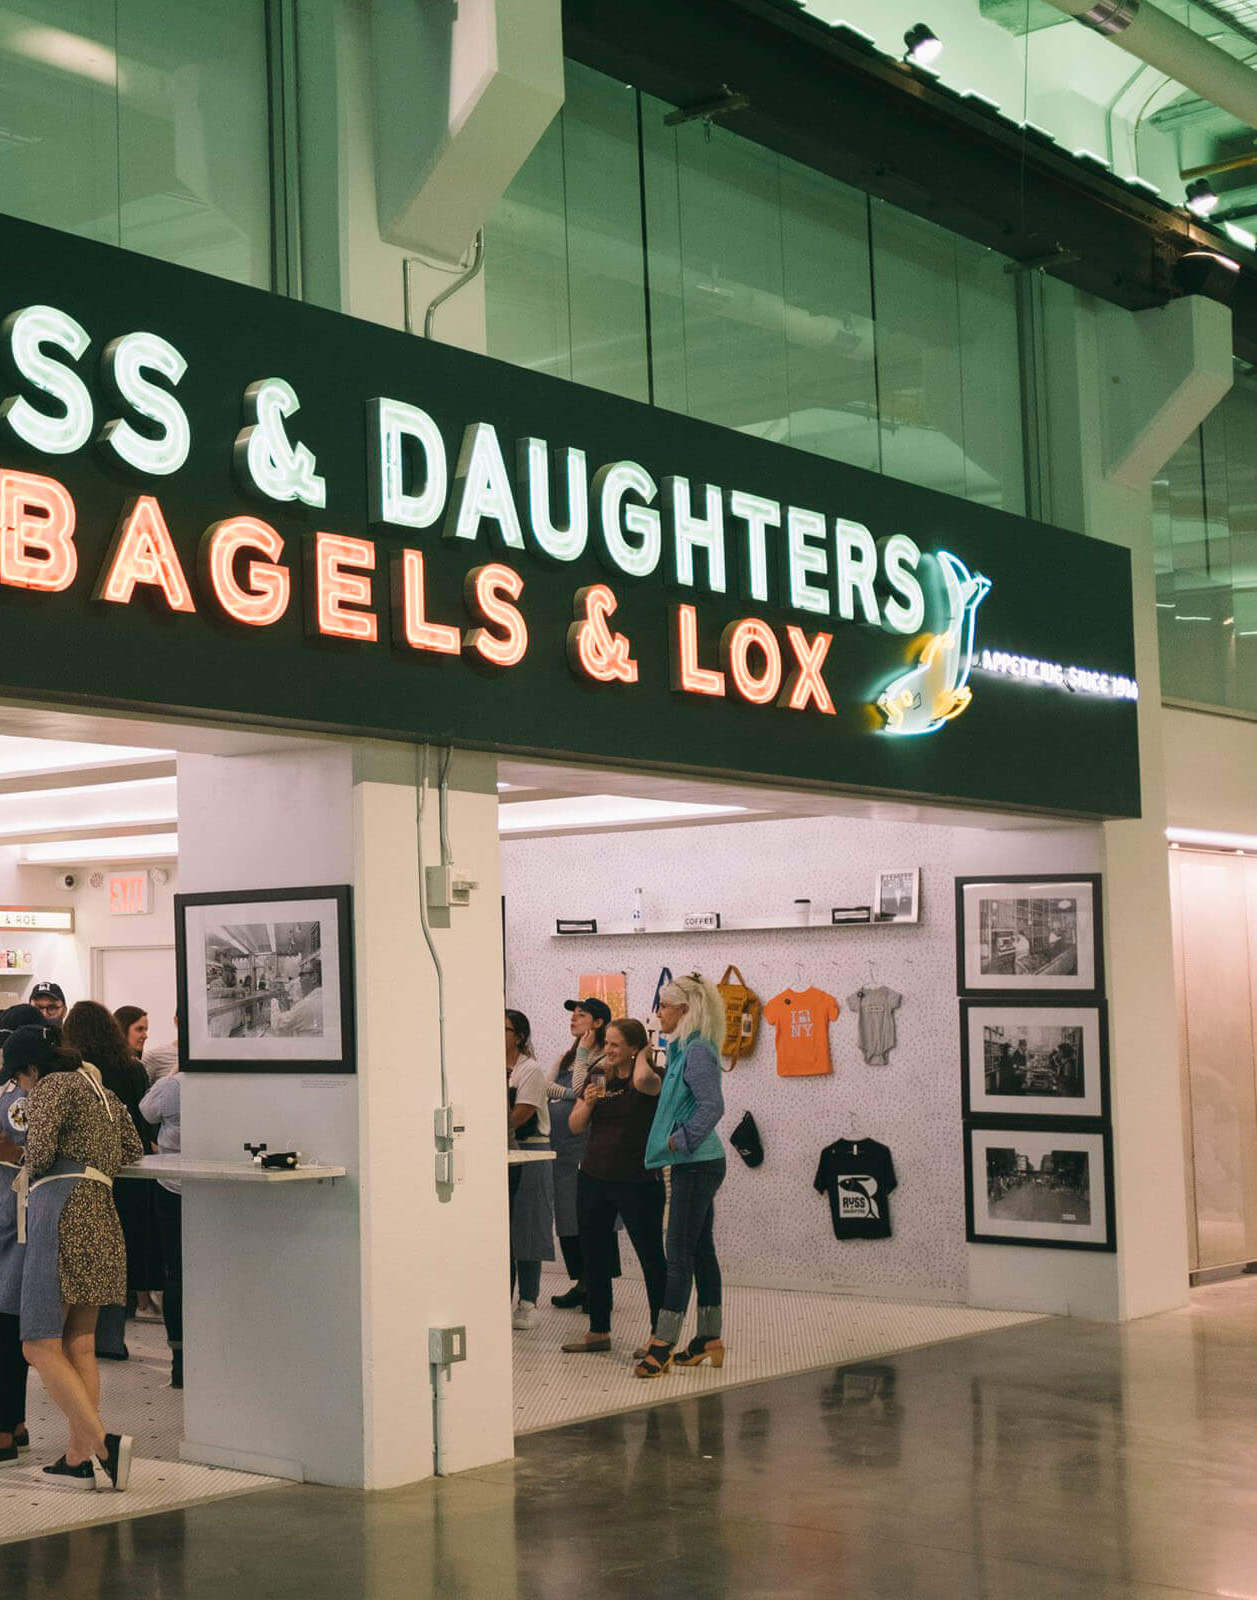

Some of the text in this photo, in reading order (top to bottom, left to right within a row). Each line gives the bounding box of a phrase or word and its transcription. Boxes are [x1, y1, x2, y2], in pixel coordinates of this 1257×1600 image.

[235, 377, 327, 509] &
[367, 396, 926, 635] DAUGHTERS
[567, 583, 639, 684] &
[670, 603, 837, 715] LOX
[108, 876, 143, 913] EXIT
[4, 915, 12, 925] &
[15, 915, 37, 926] ROE
[842, 1197, 866, 1209] RUSS
